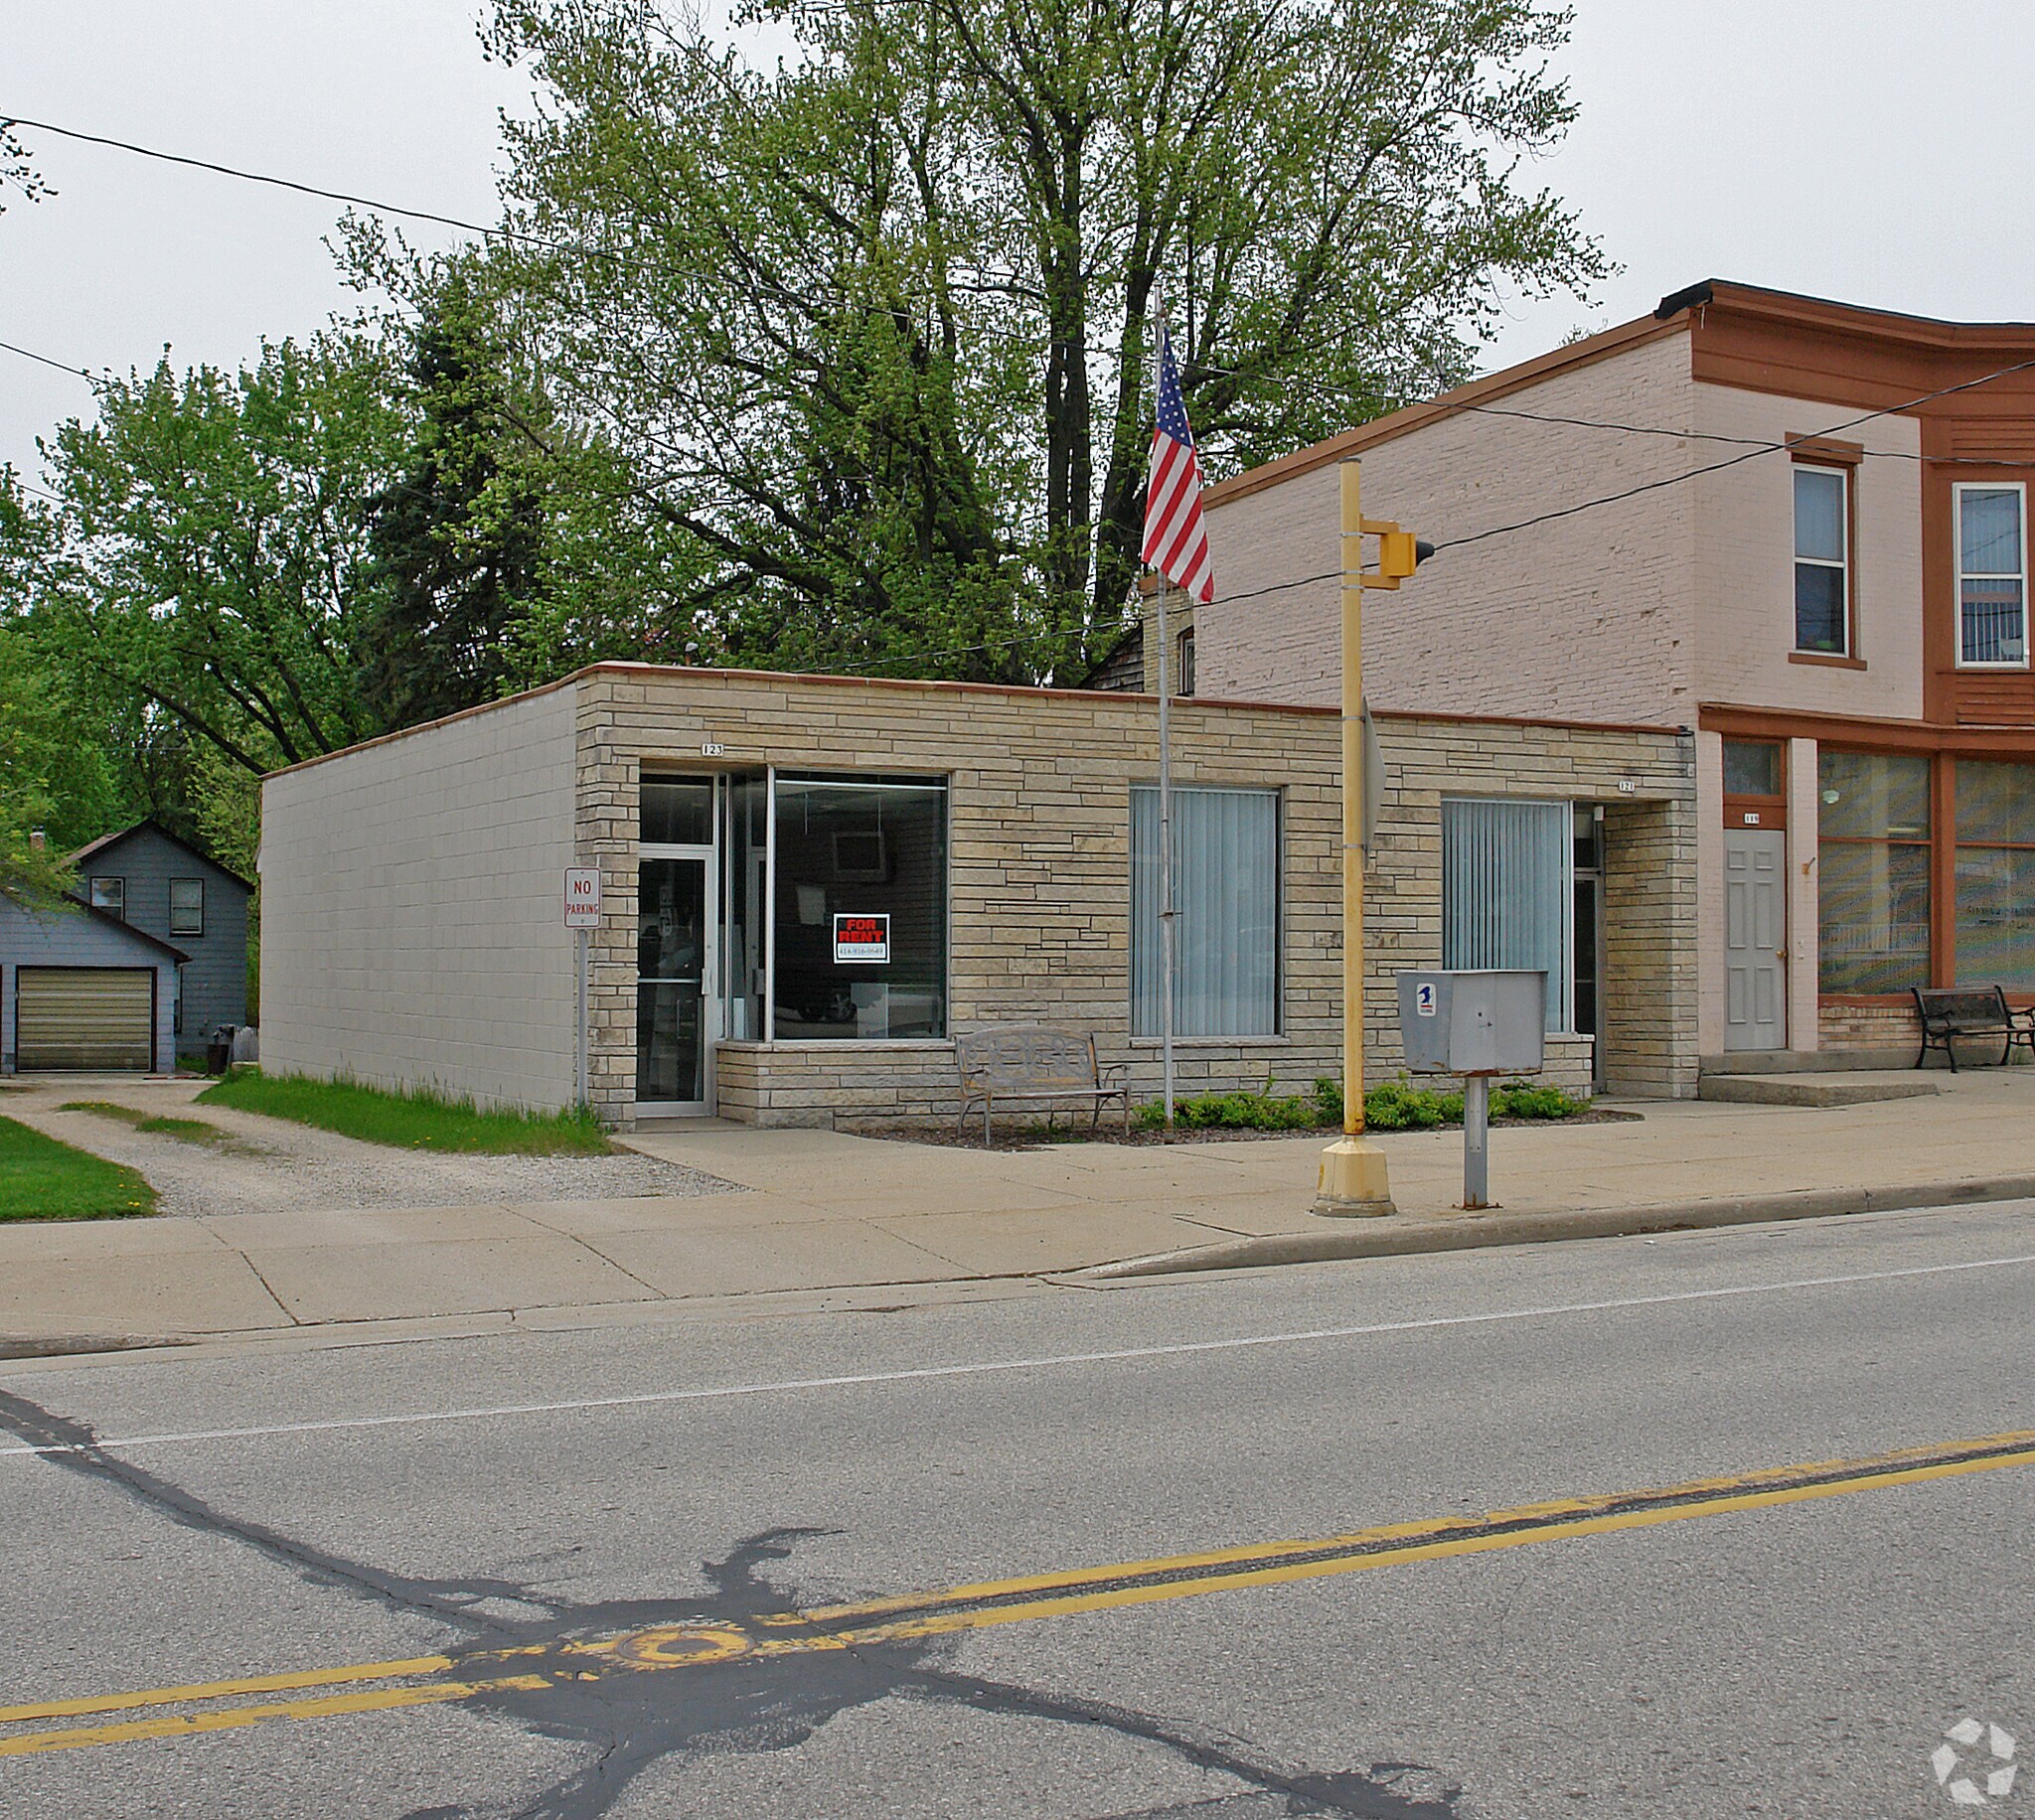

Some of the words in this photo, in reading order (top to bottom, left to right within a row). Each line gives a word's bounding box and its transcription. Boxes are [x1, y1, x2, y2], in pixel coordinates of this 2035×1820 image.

[704, 745, 722, 754] 123
[573, 880, 591, 894] NO
[566, 903, 598, 915] PARKING
[847, 919, 876, 931] FOR
[839, 930, 884, 943] RENT
